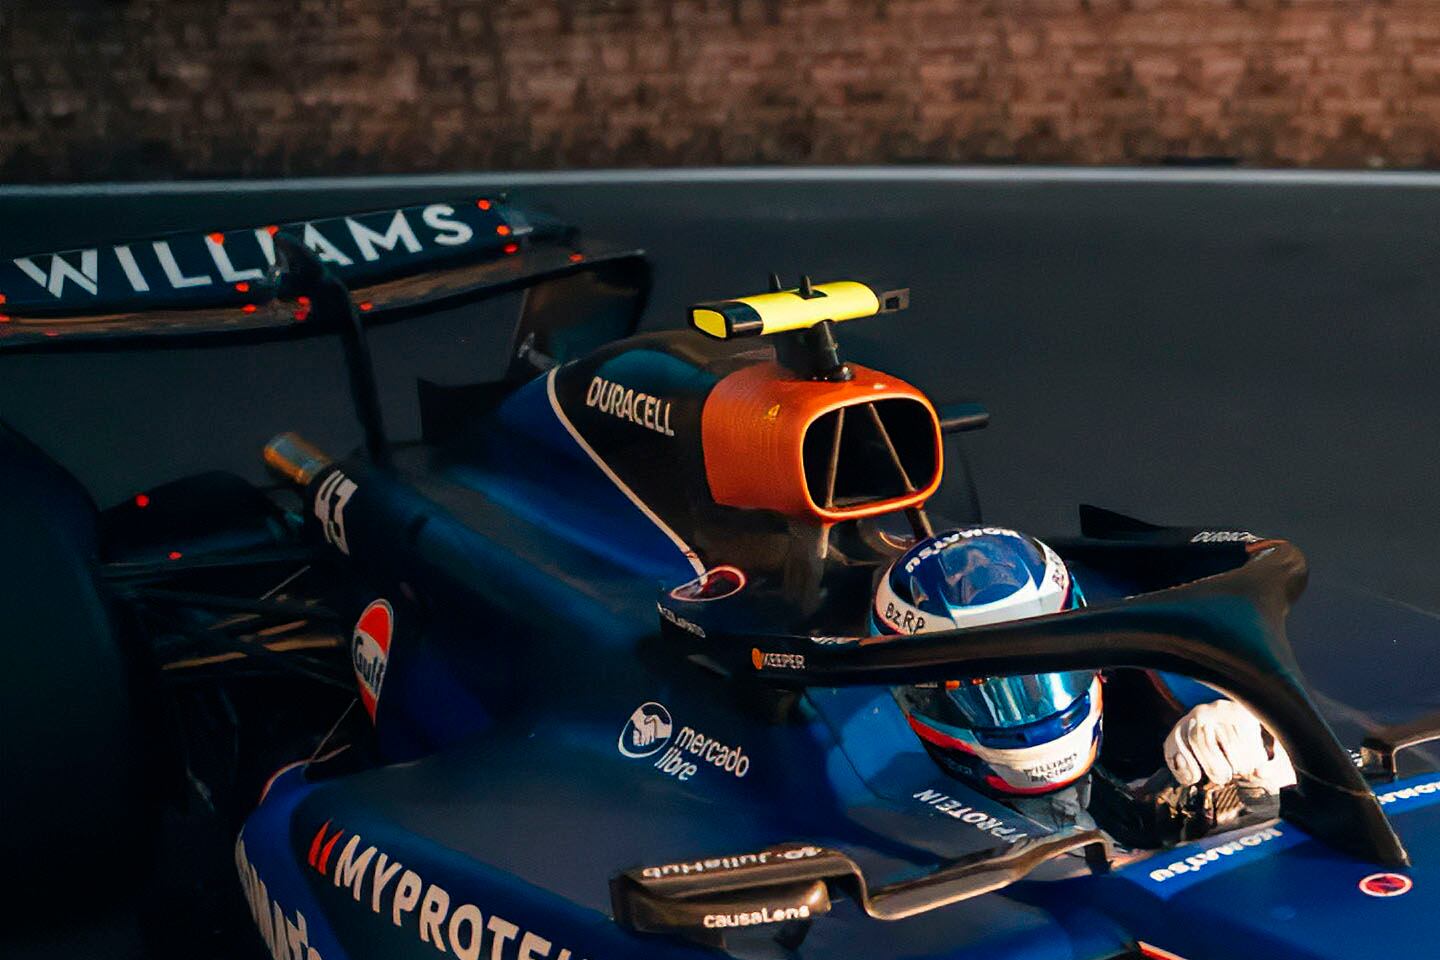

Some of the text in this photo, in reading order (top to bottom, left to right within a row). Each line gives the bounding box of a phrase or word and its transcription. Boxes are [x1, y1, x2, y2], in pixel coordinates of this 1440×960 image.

[586, 376, 675, 437] DURACELL
[654, 747, 698, 780] libre
[675, 726, 749, 777] mercado
[913, 789, 1028, 844] YPROTEIN
